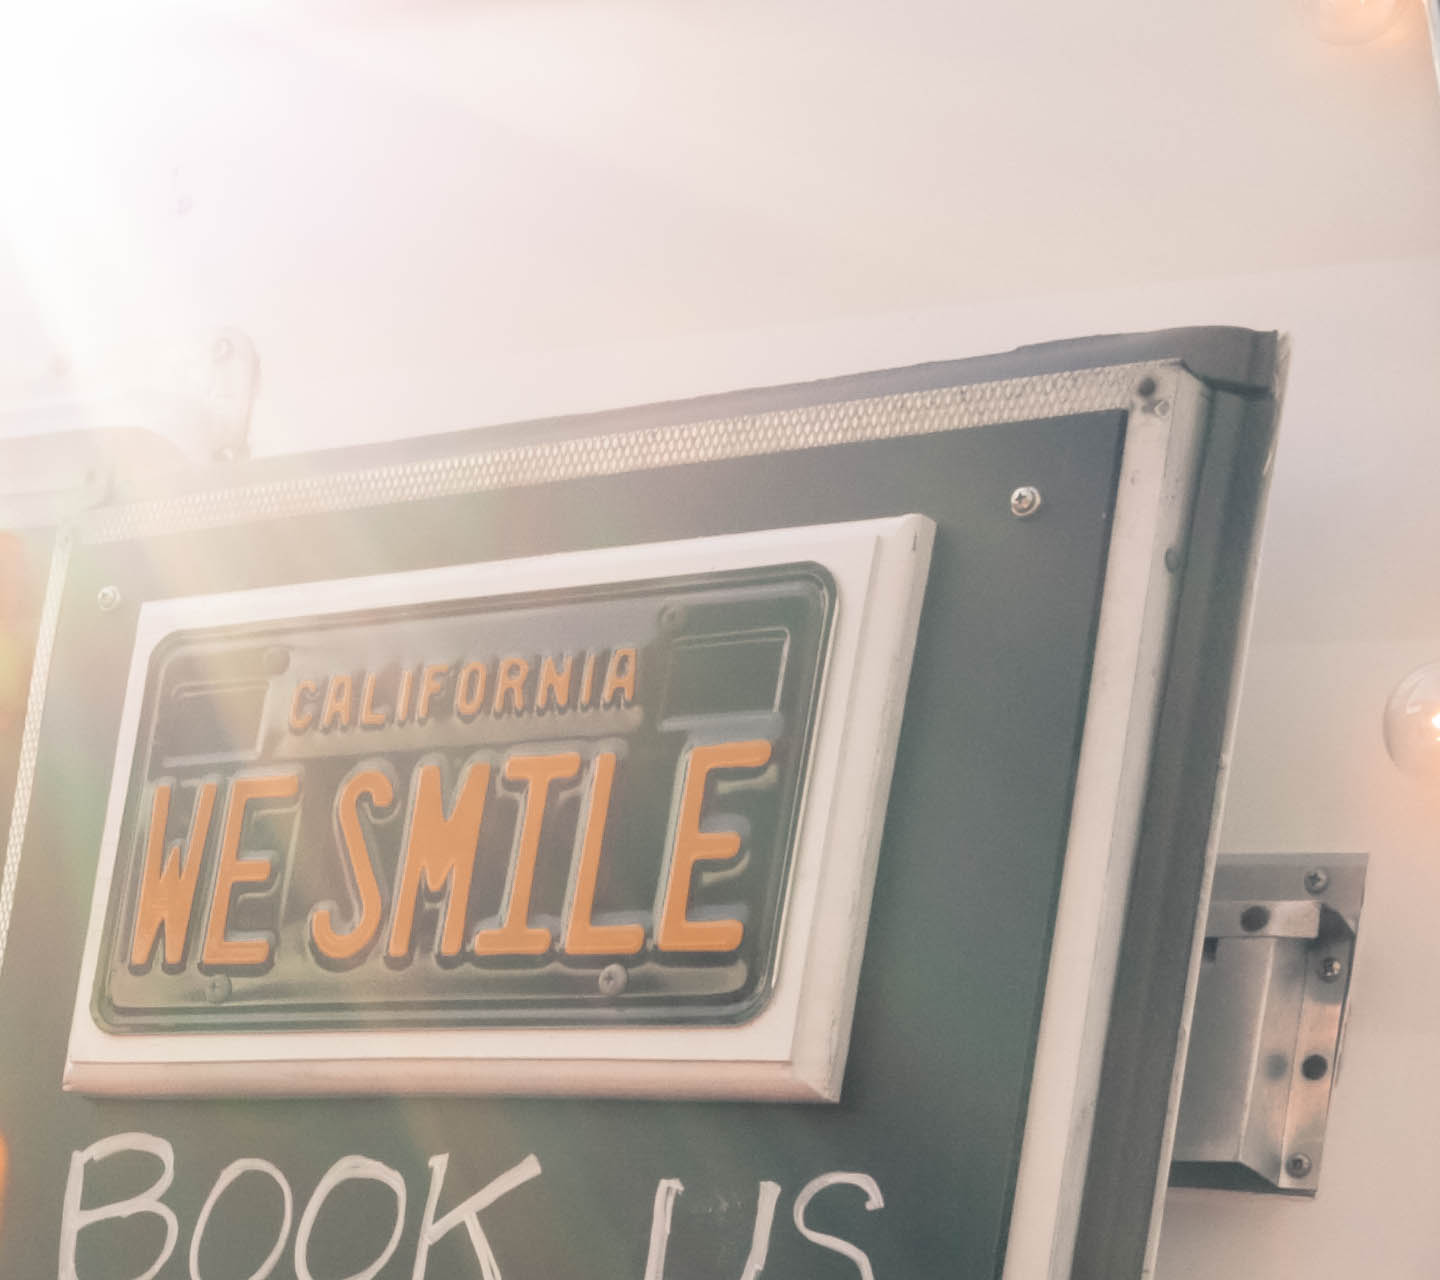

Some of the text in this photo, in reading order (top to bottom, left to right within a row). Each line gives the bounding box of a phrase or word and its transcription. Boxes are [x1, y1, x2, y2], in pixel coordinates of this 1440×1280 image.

[288, 646, 639, 733] CALIFORNIA
[129, 738, 773, 966] WE SMILE
